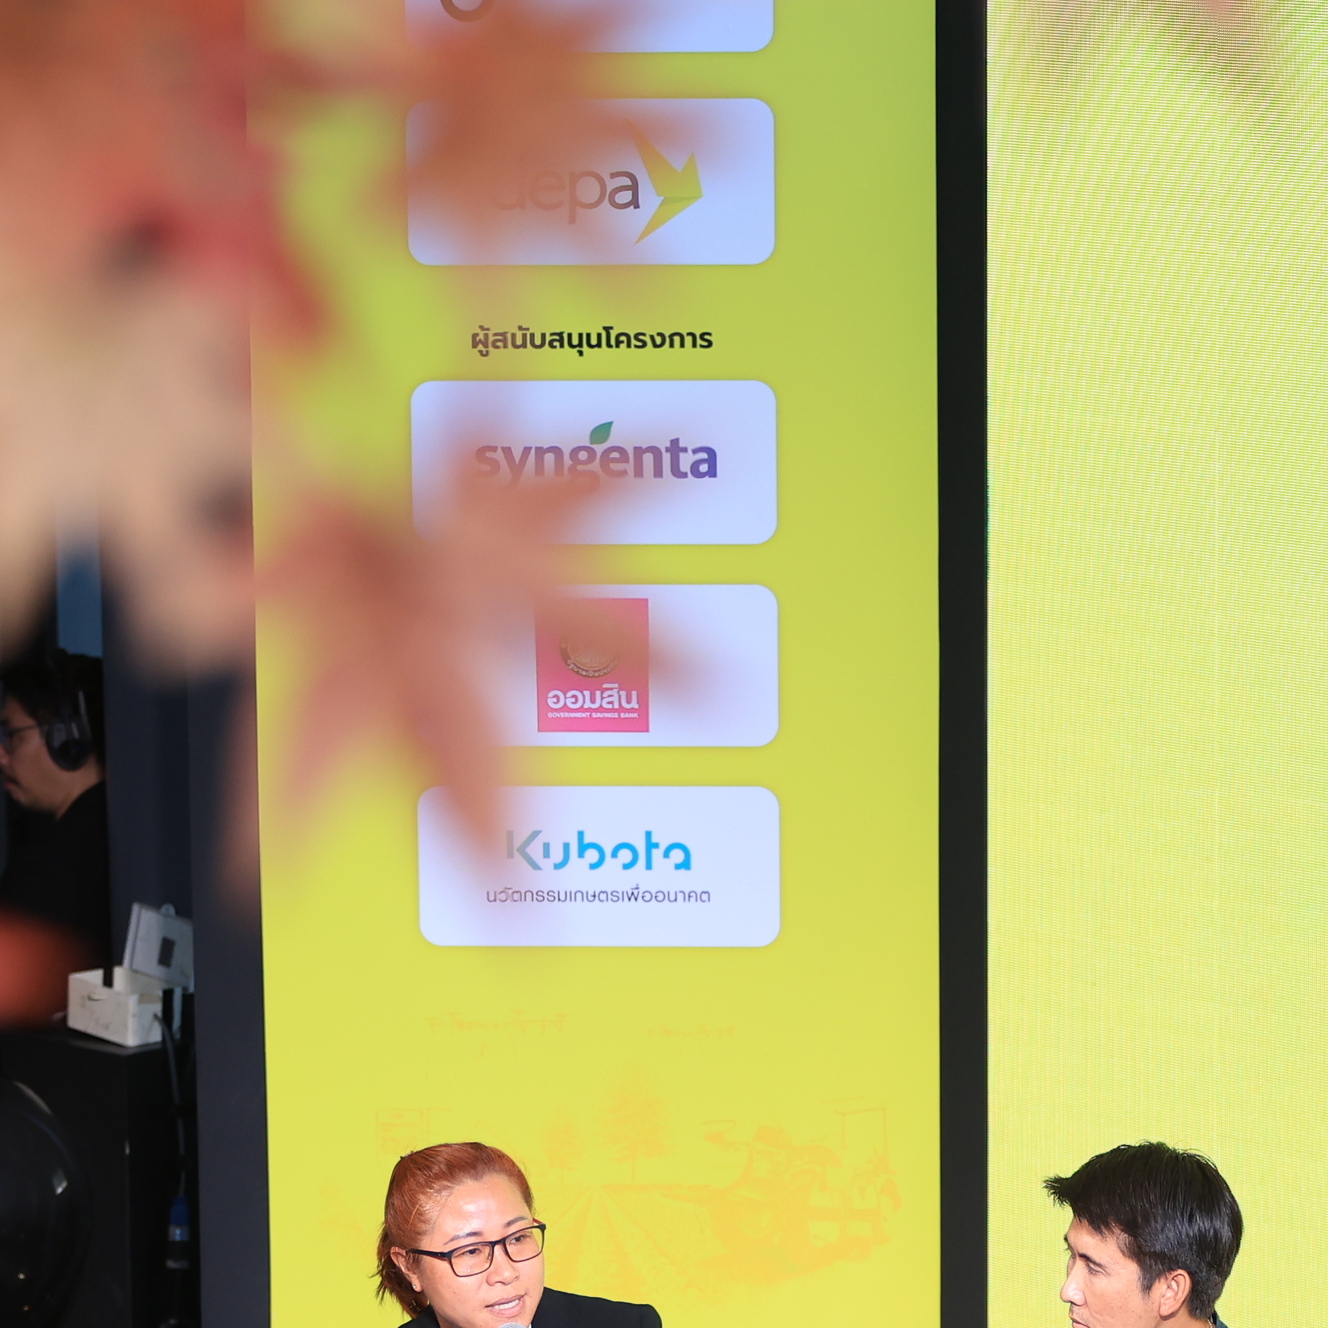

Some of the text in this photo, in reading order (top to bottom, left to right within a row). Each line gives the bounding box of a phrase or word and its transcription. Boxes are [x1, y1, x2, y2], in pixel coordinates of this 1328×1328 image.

[471, 324, 714, 357] ผู้สนับสนุนโครงการ
[475, 437, 718, 494] syngenta
[547, 682, 640, 709] ออมสิน
[485, 883, 711, 903] นวัตกรรมเกษตรเพื่ออนาคต
